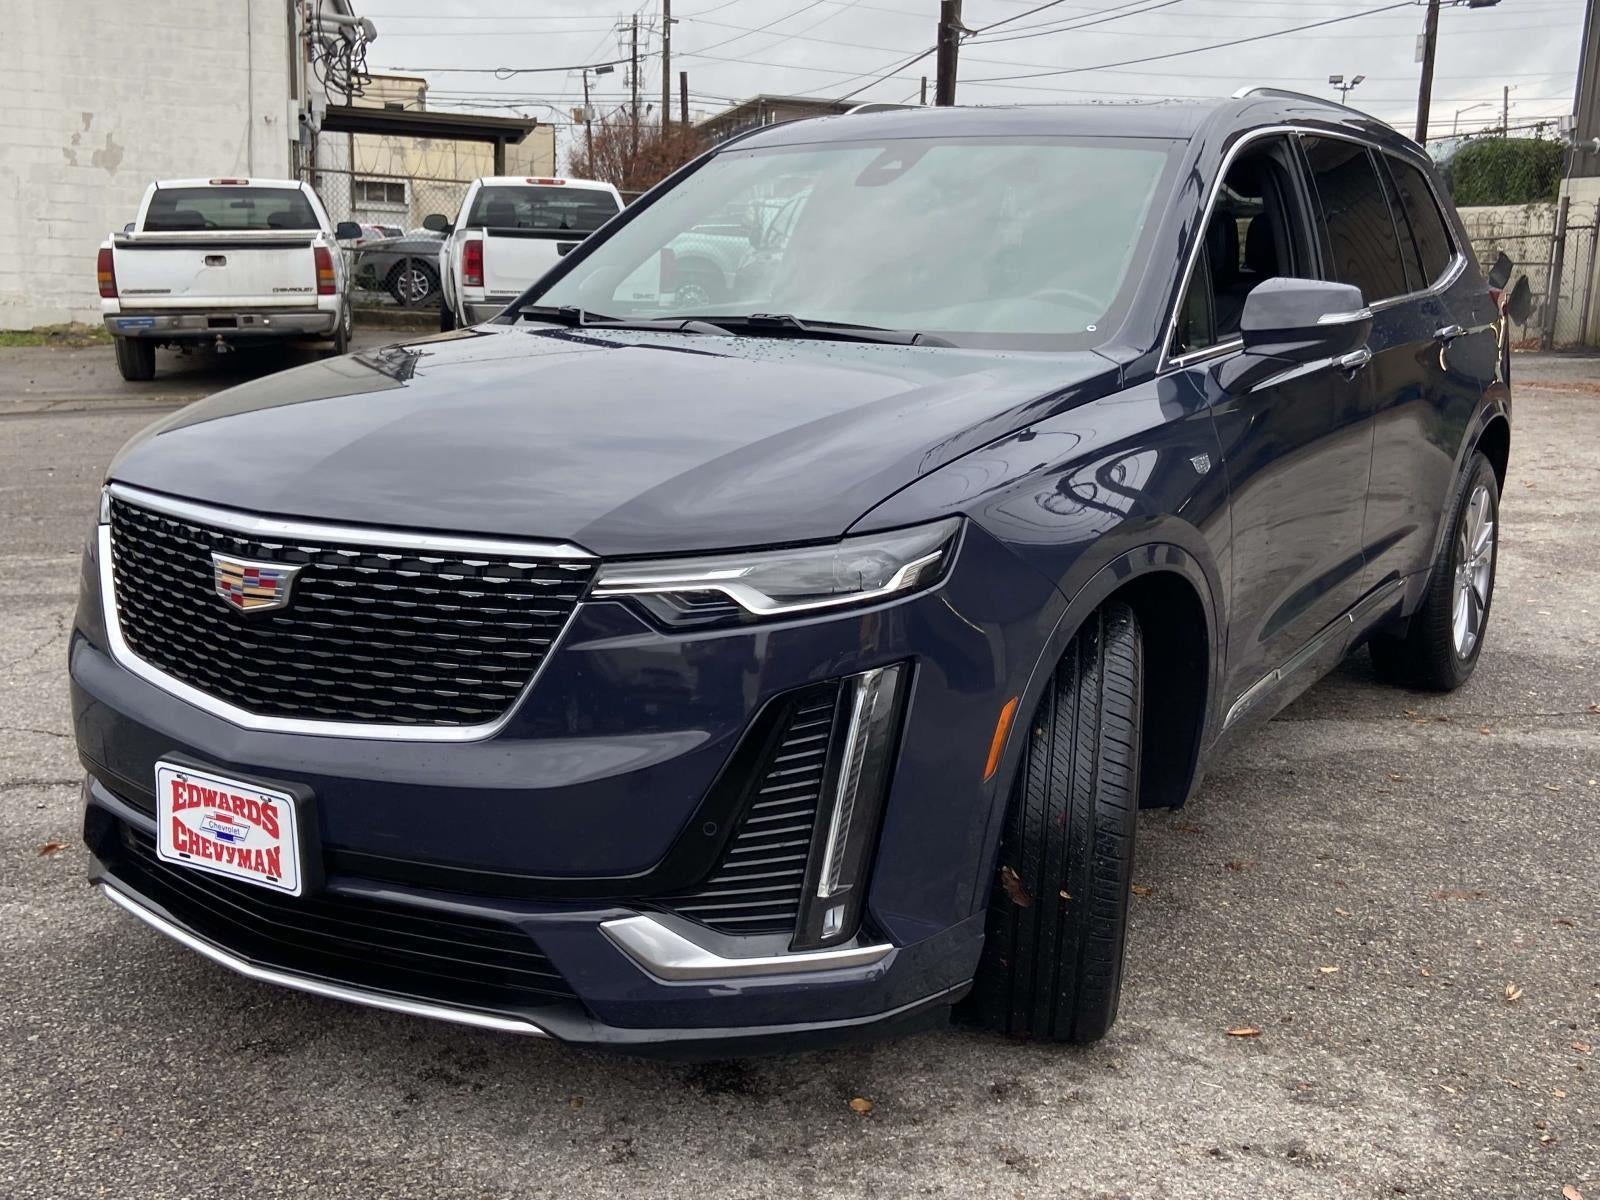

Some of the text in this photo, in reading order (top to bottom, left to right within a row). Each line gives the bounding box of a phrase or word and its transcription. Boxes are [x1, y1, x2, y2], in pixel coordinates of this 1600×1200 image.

[171, 780, 280, 840] EDWARDS
[208, 820, 241, 836] Chevrolet
[172, 815, 282, 879] CHEVYMAN
